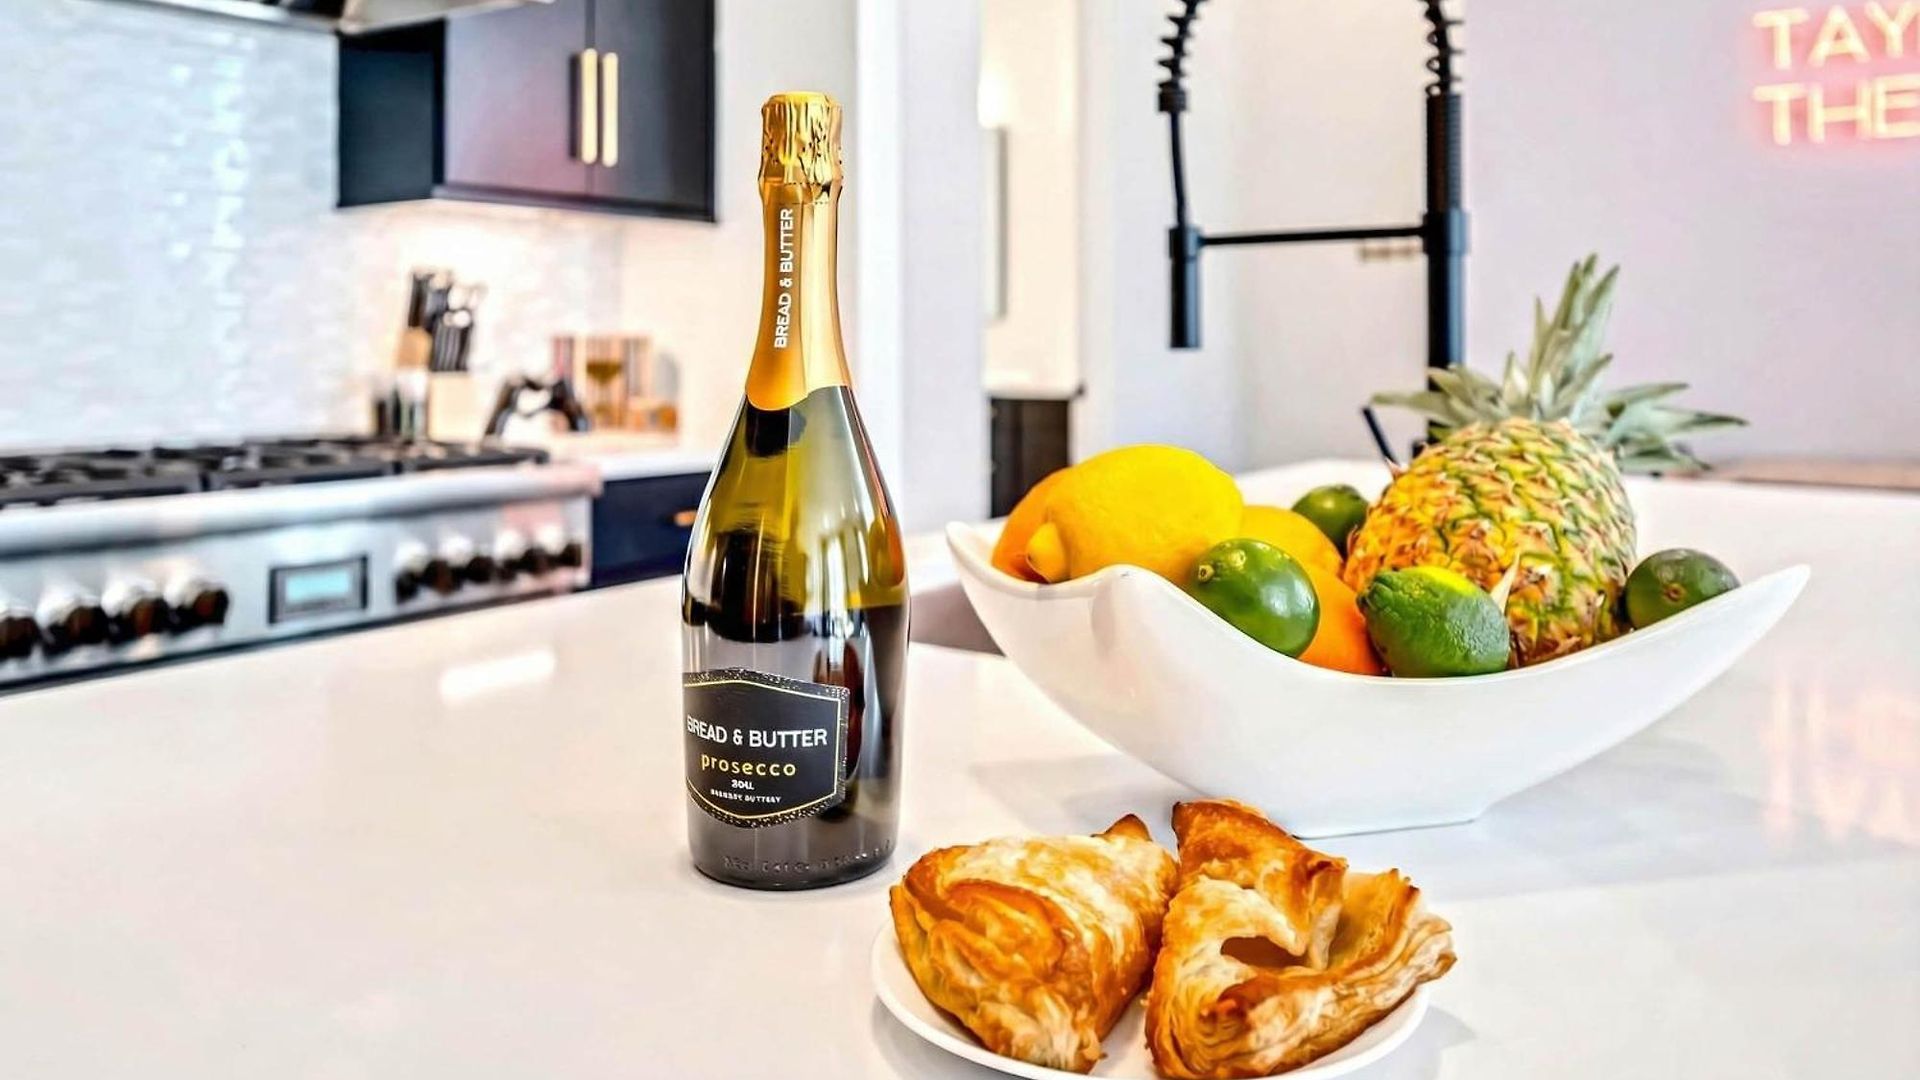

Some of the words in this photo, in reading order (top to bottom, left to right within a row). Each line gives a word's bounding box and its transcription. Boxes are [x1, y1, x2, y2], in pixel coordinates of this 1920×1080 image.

[1753, 0, 1920, 70] TAY
[1753, 74, 1920, 145] THE
[779, 208, 794, 273] BUTTER
[779, 277, 793, 288] &
[774, 292, 791, 348] BREAD
[687, 714, 727, 743] BREAD
[732, 728, 744, 746] &
[749, 728, 827, 748] BUTTER
[701, 753, 796, 776] prosecco
